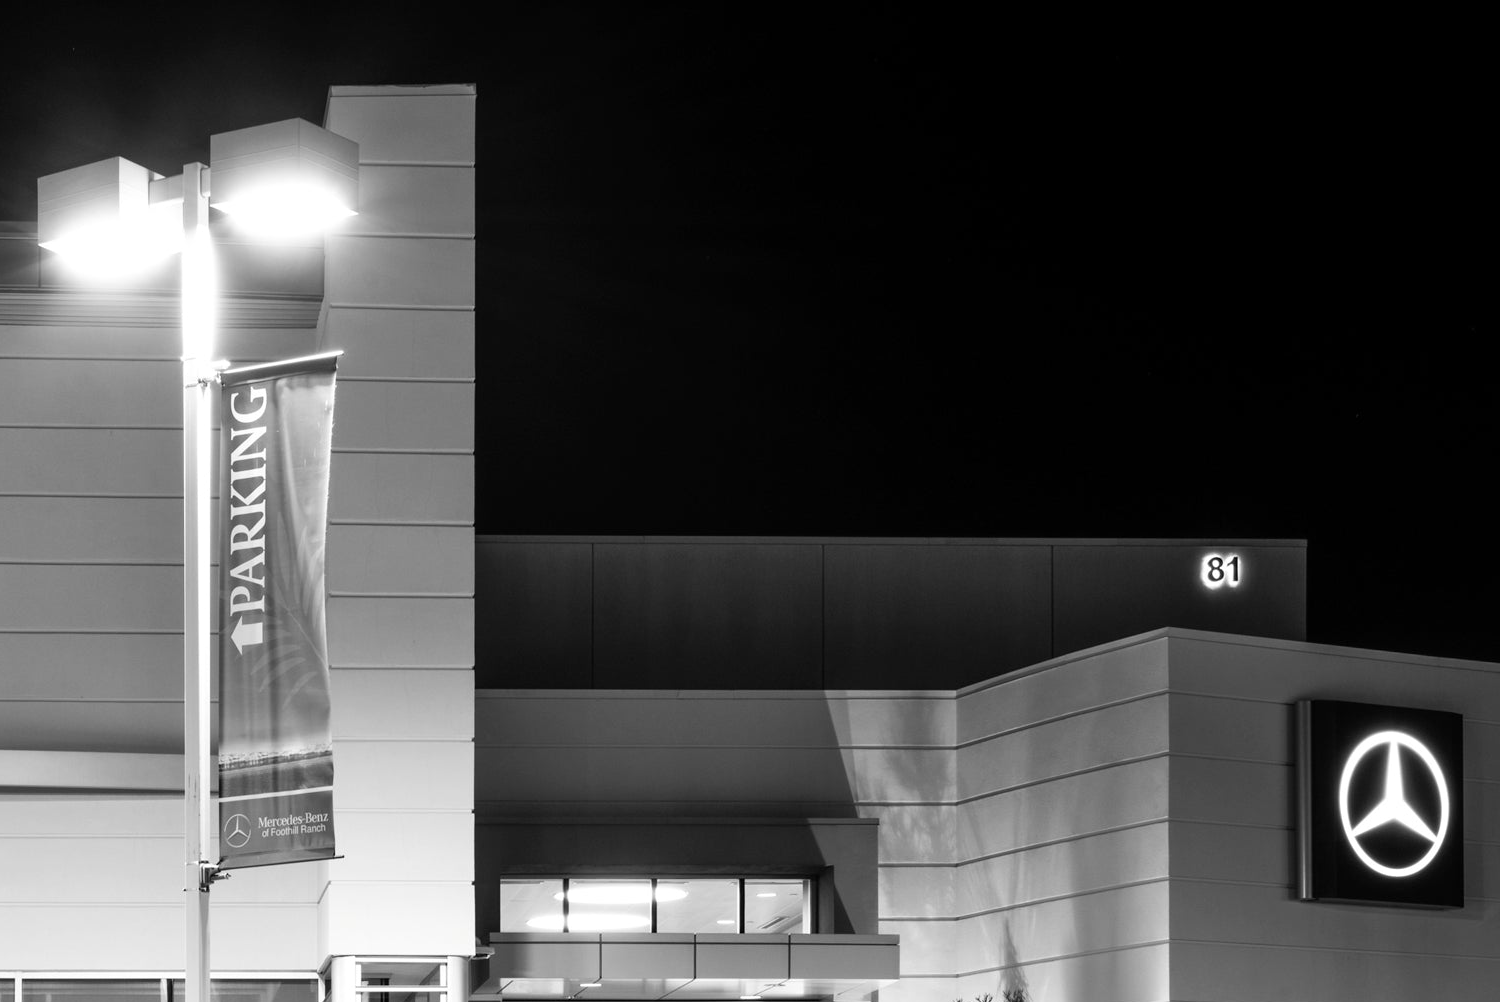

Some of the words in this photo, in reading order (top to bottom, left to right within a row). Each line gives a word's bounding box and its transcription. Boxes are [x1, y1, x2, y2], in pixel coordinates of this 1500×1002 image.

[230, 386, 267, 617] PARKING
[1207, 556, 1239, 582] 81
[258, 812, 329, 828] Mercedes-Benz
[261, 828, 269, 838] of
[270, 825, 299, 837] Foothill
[301, 823, 326, 834] Ranch
